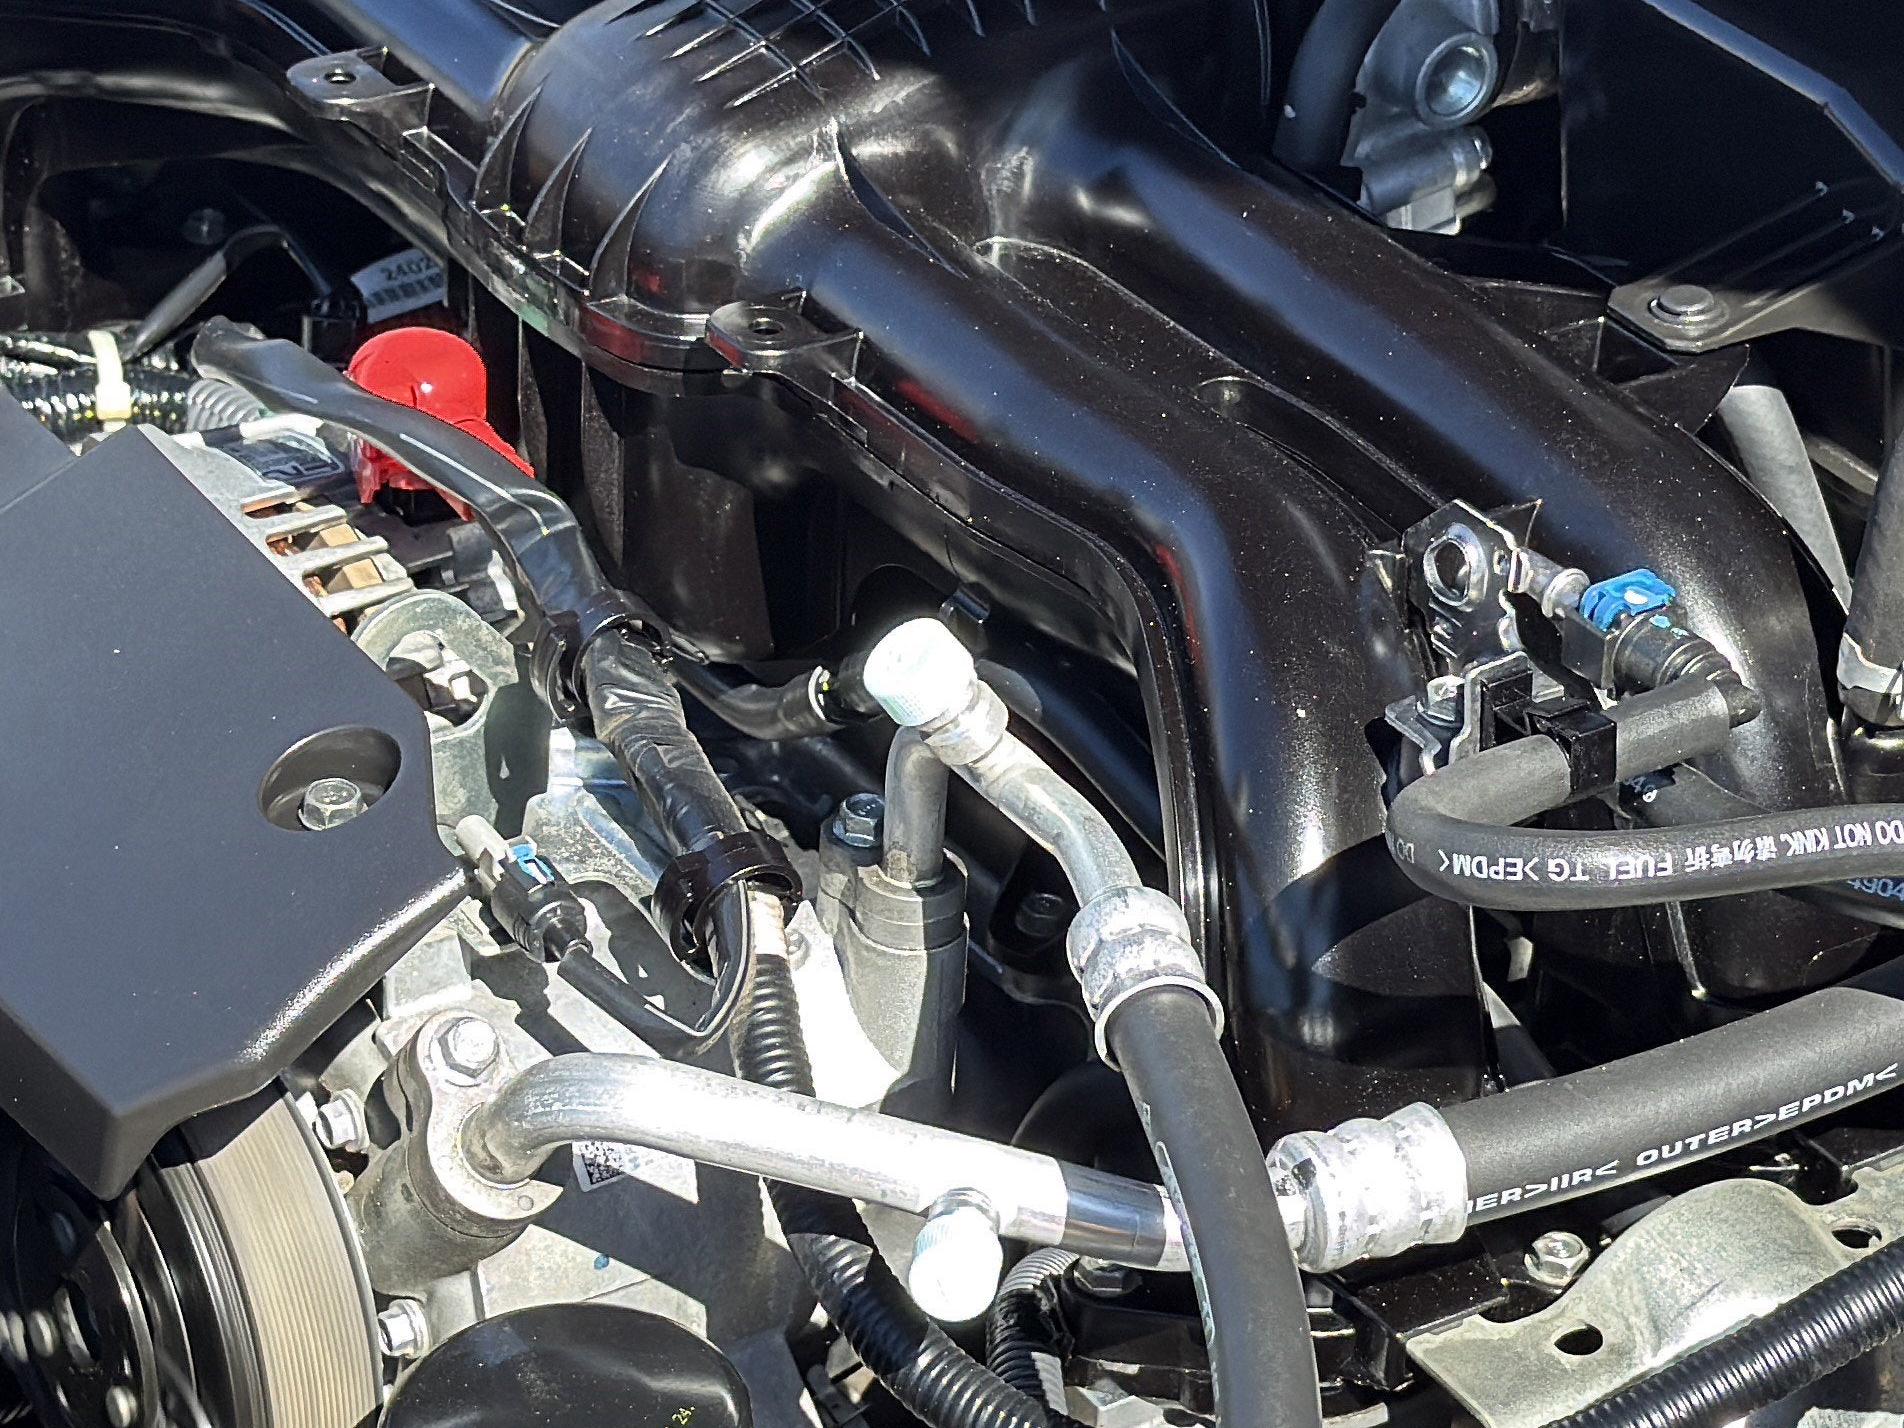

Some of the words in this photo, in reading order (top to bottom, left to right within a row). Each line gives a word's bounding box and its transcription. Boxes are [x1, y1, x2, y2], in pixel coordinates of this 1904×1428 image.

[1832, 821, 1872, 849] NOT
[1874, 819, 1904, 846] DO
[1435, 845, 1539, 885] >EPDM<
[1601, 851, 1673, 880] FUEL
[1683, 834, 1776, 871] 请勿弯折
[1547, 855, 1587, 882] TG
[1631, 1061, 1904, 1170] OUTER>EPDM<
